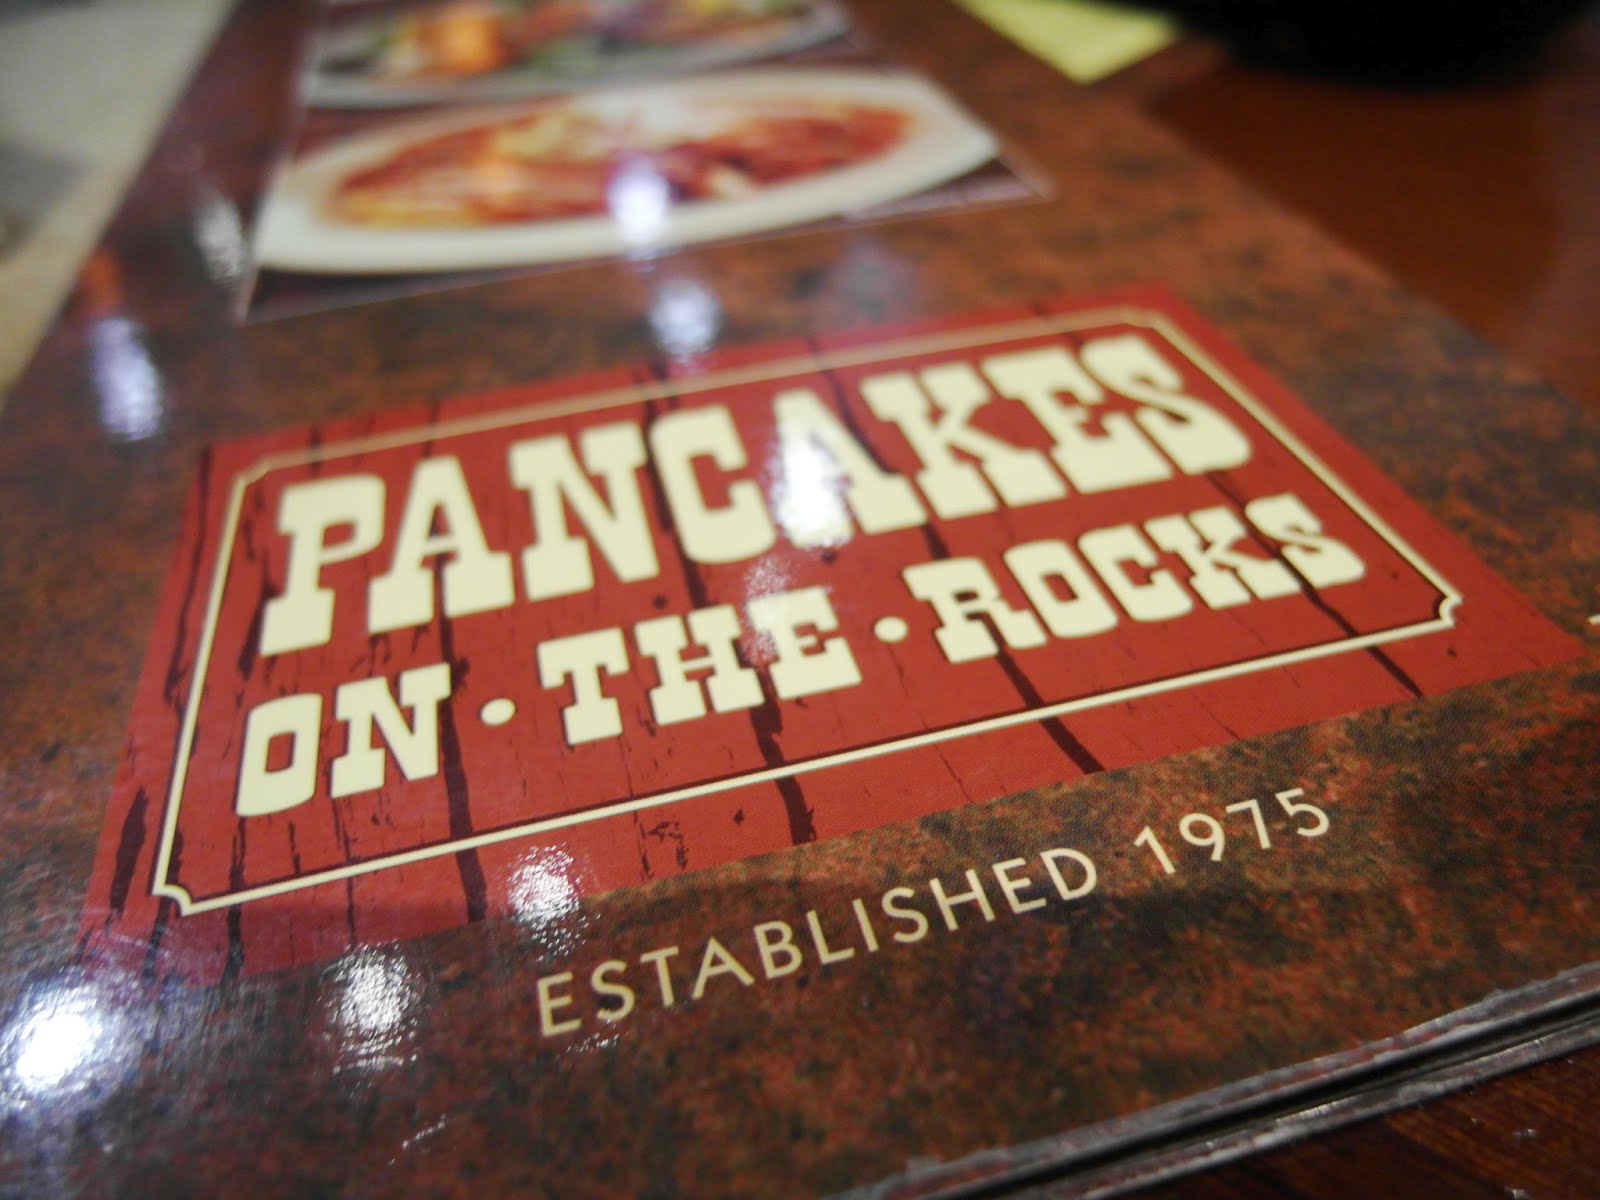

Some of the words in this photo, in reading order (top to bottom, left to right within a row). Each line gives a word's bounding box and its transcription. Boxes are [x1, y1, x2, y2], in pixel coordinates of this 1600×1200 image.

[236, 664, 451, 817] ON
[537, 586, 862, 745] THE
[902, 492, 1365, 664] ROCKS
[260, 335, 1251, 656] PANCAKES
[537, 847, 1098, 1036] ESTABLISHED
[1133, 788, 1331, 876] 1975
